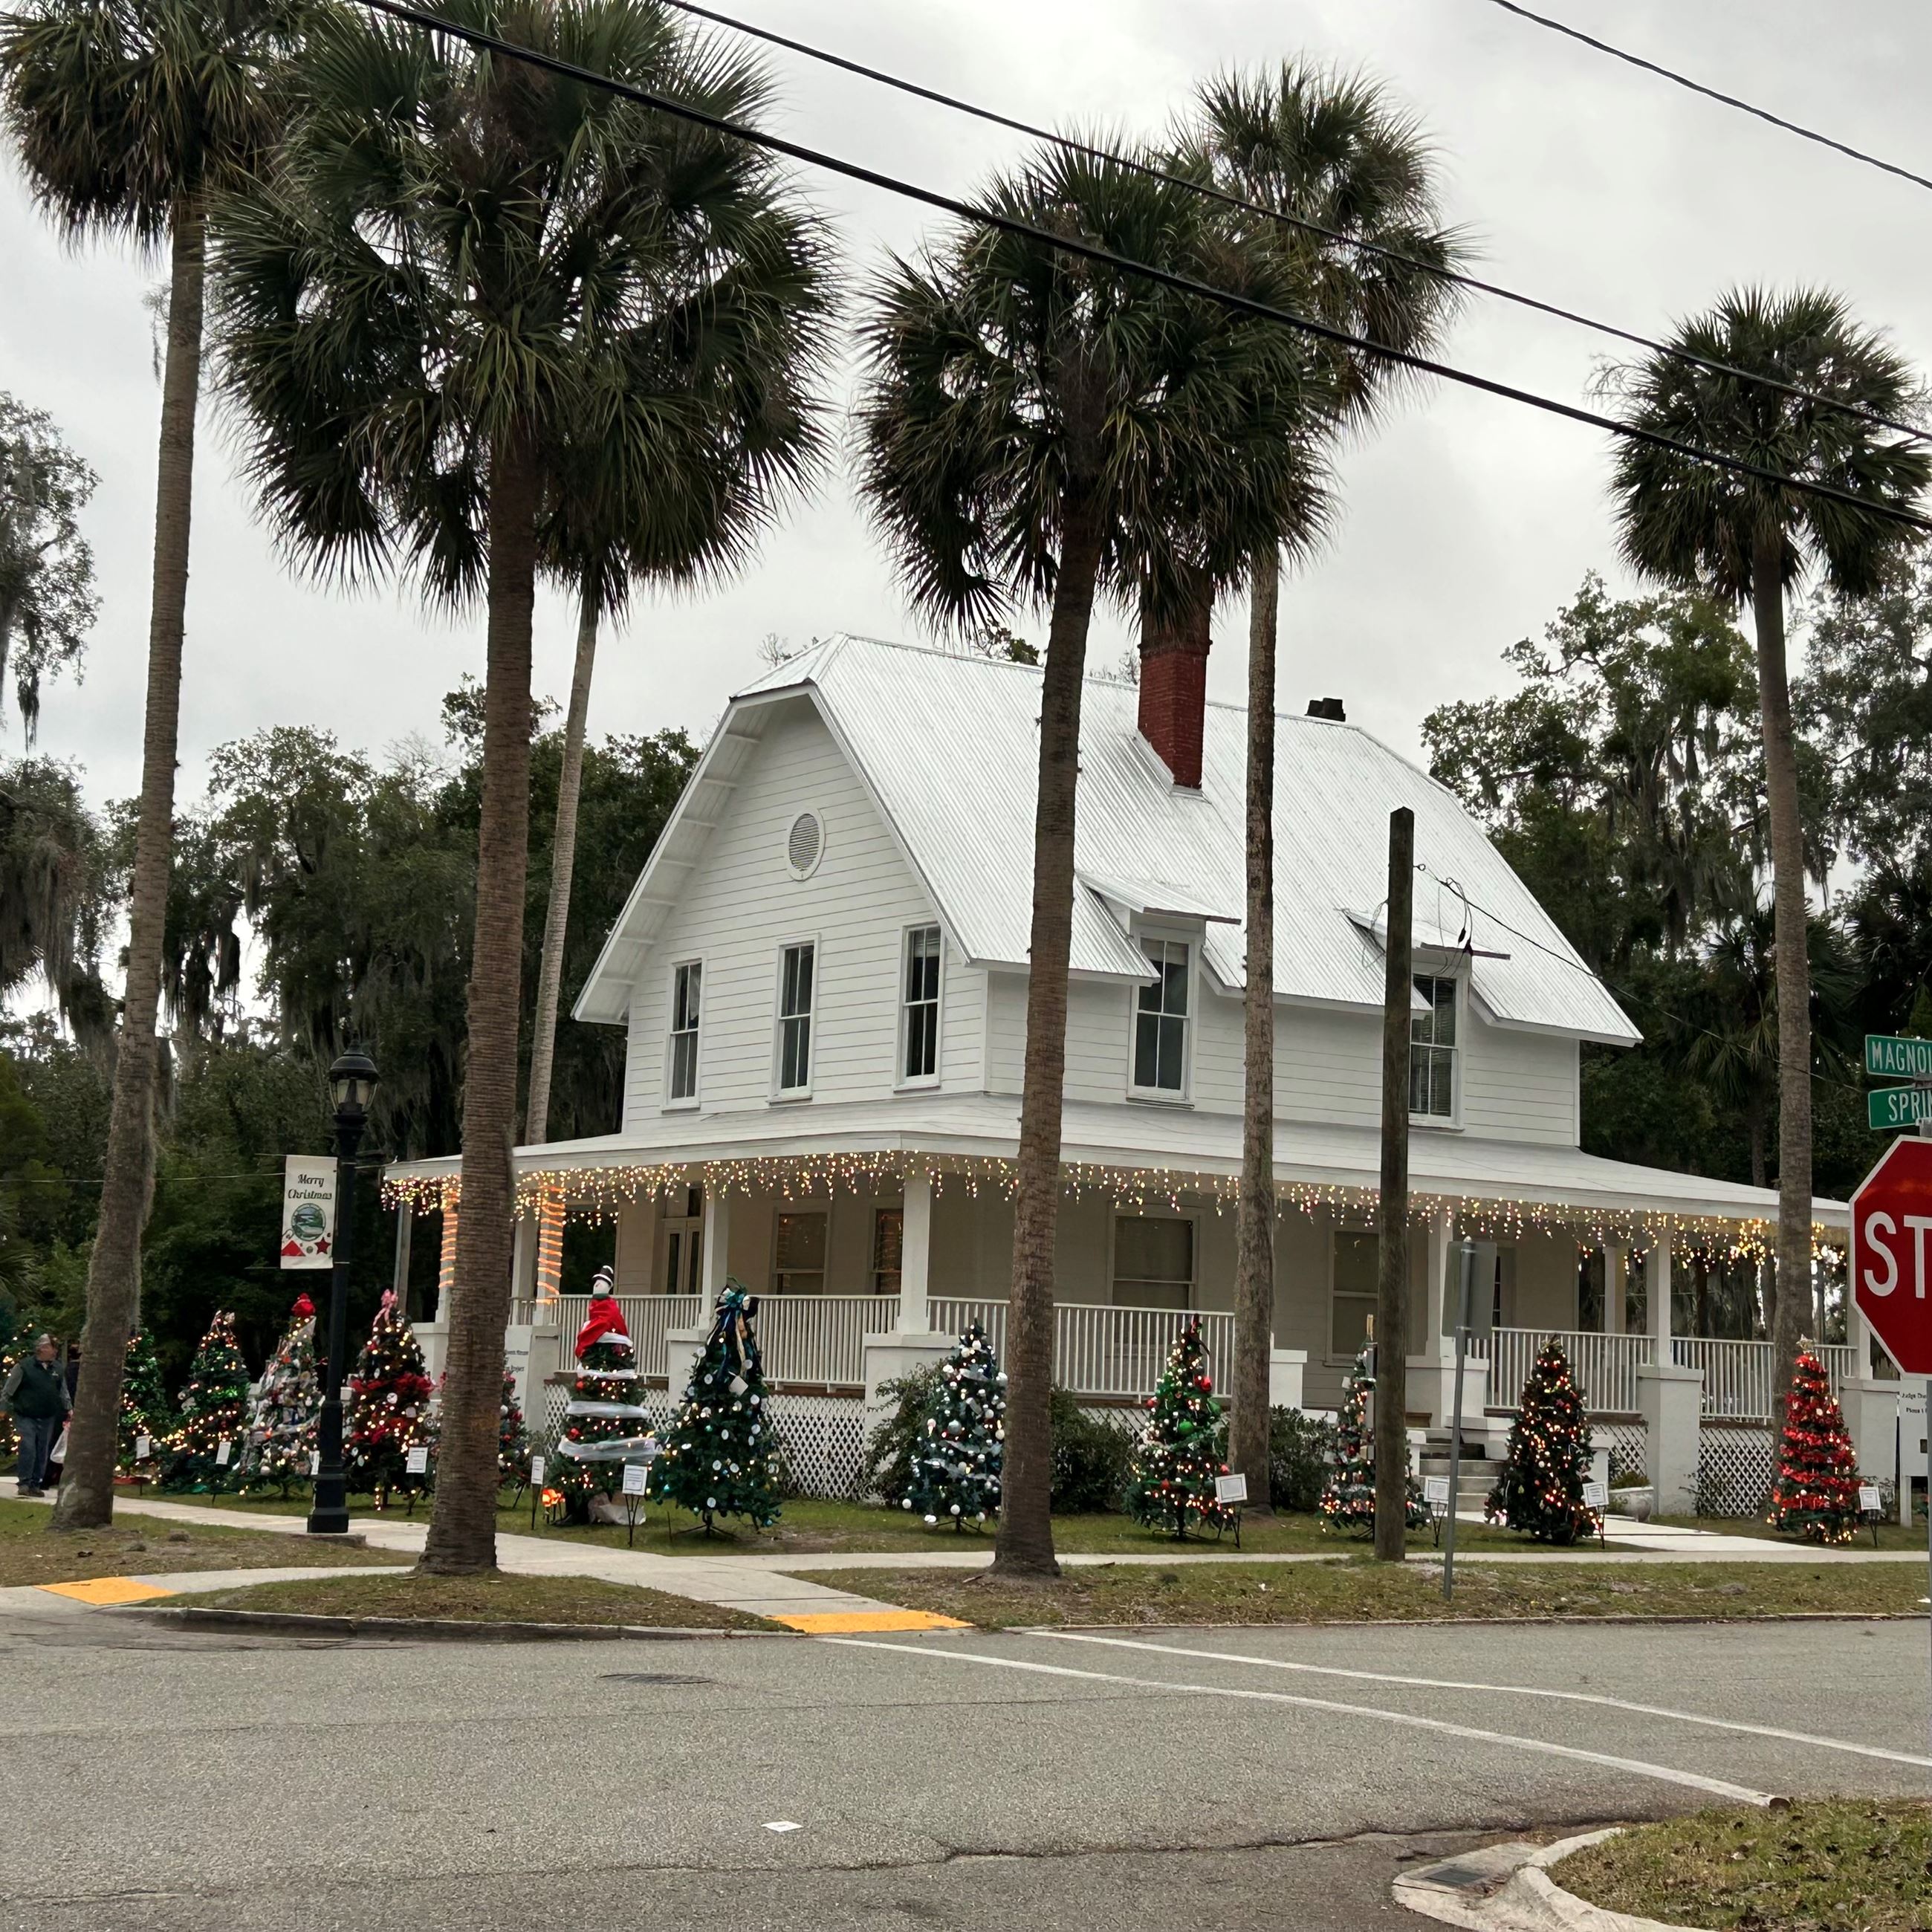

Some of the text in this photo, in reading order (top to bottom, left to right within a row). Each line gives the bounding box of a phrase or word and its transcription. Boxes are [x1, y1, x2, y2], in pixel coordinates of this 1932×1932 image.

[297, 1174, 325, 1187] Merry
[288, 1188, 332, 1199] Christmas
[1864, 1211, 1932, 1298] ST
